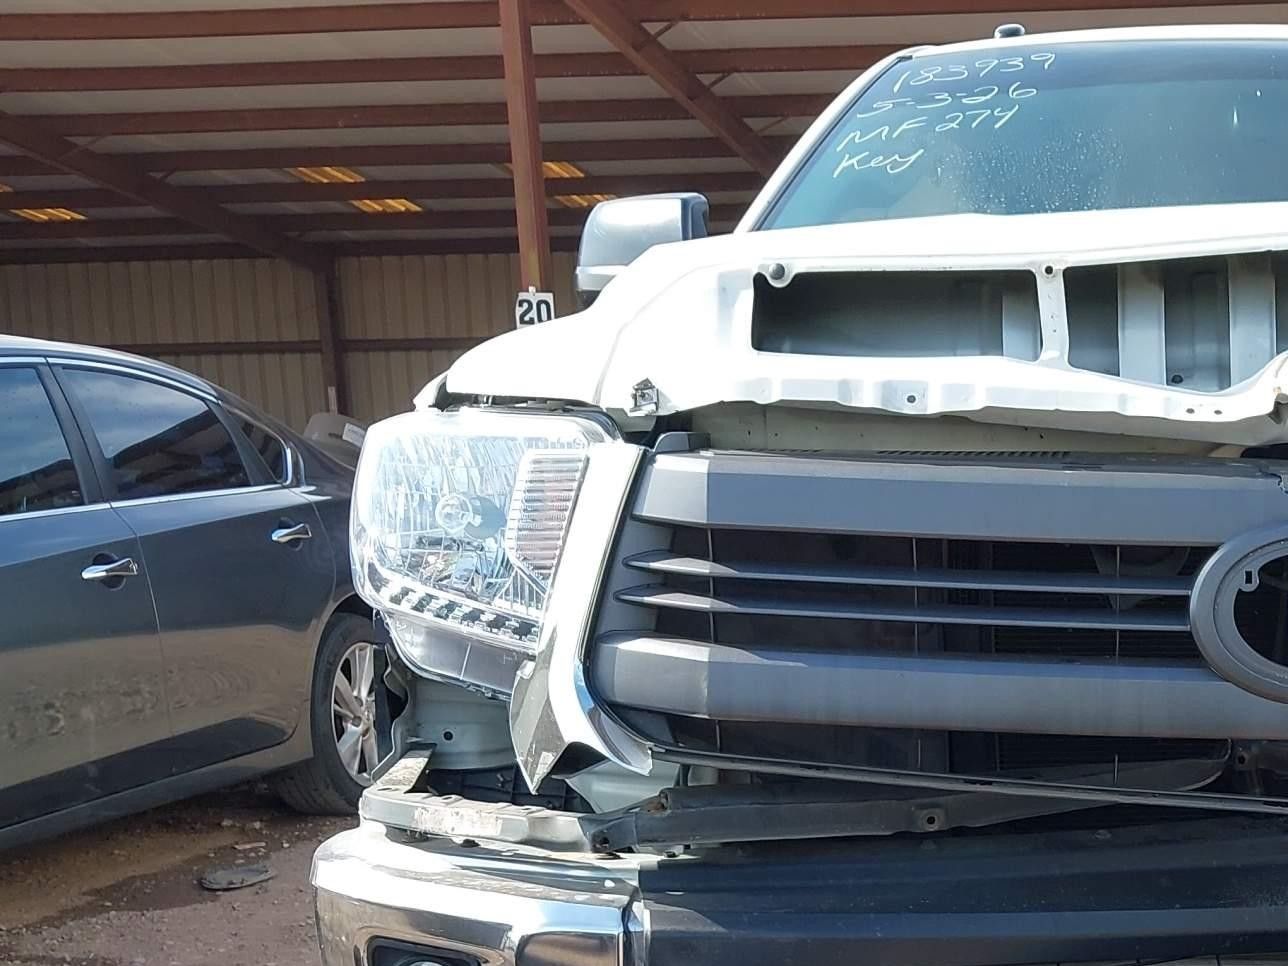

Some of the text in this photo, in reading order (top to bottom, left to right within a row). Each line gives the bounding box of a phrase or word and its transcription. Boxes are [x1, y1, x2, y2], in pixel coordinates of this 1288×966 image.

[857, 82, 1038, 118] 5-3-26
[935, 104, 1019, 130] 274
[832, 149, 925, 178] Key
[518, 299, 552, 325] 20
